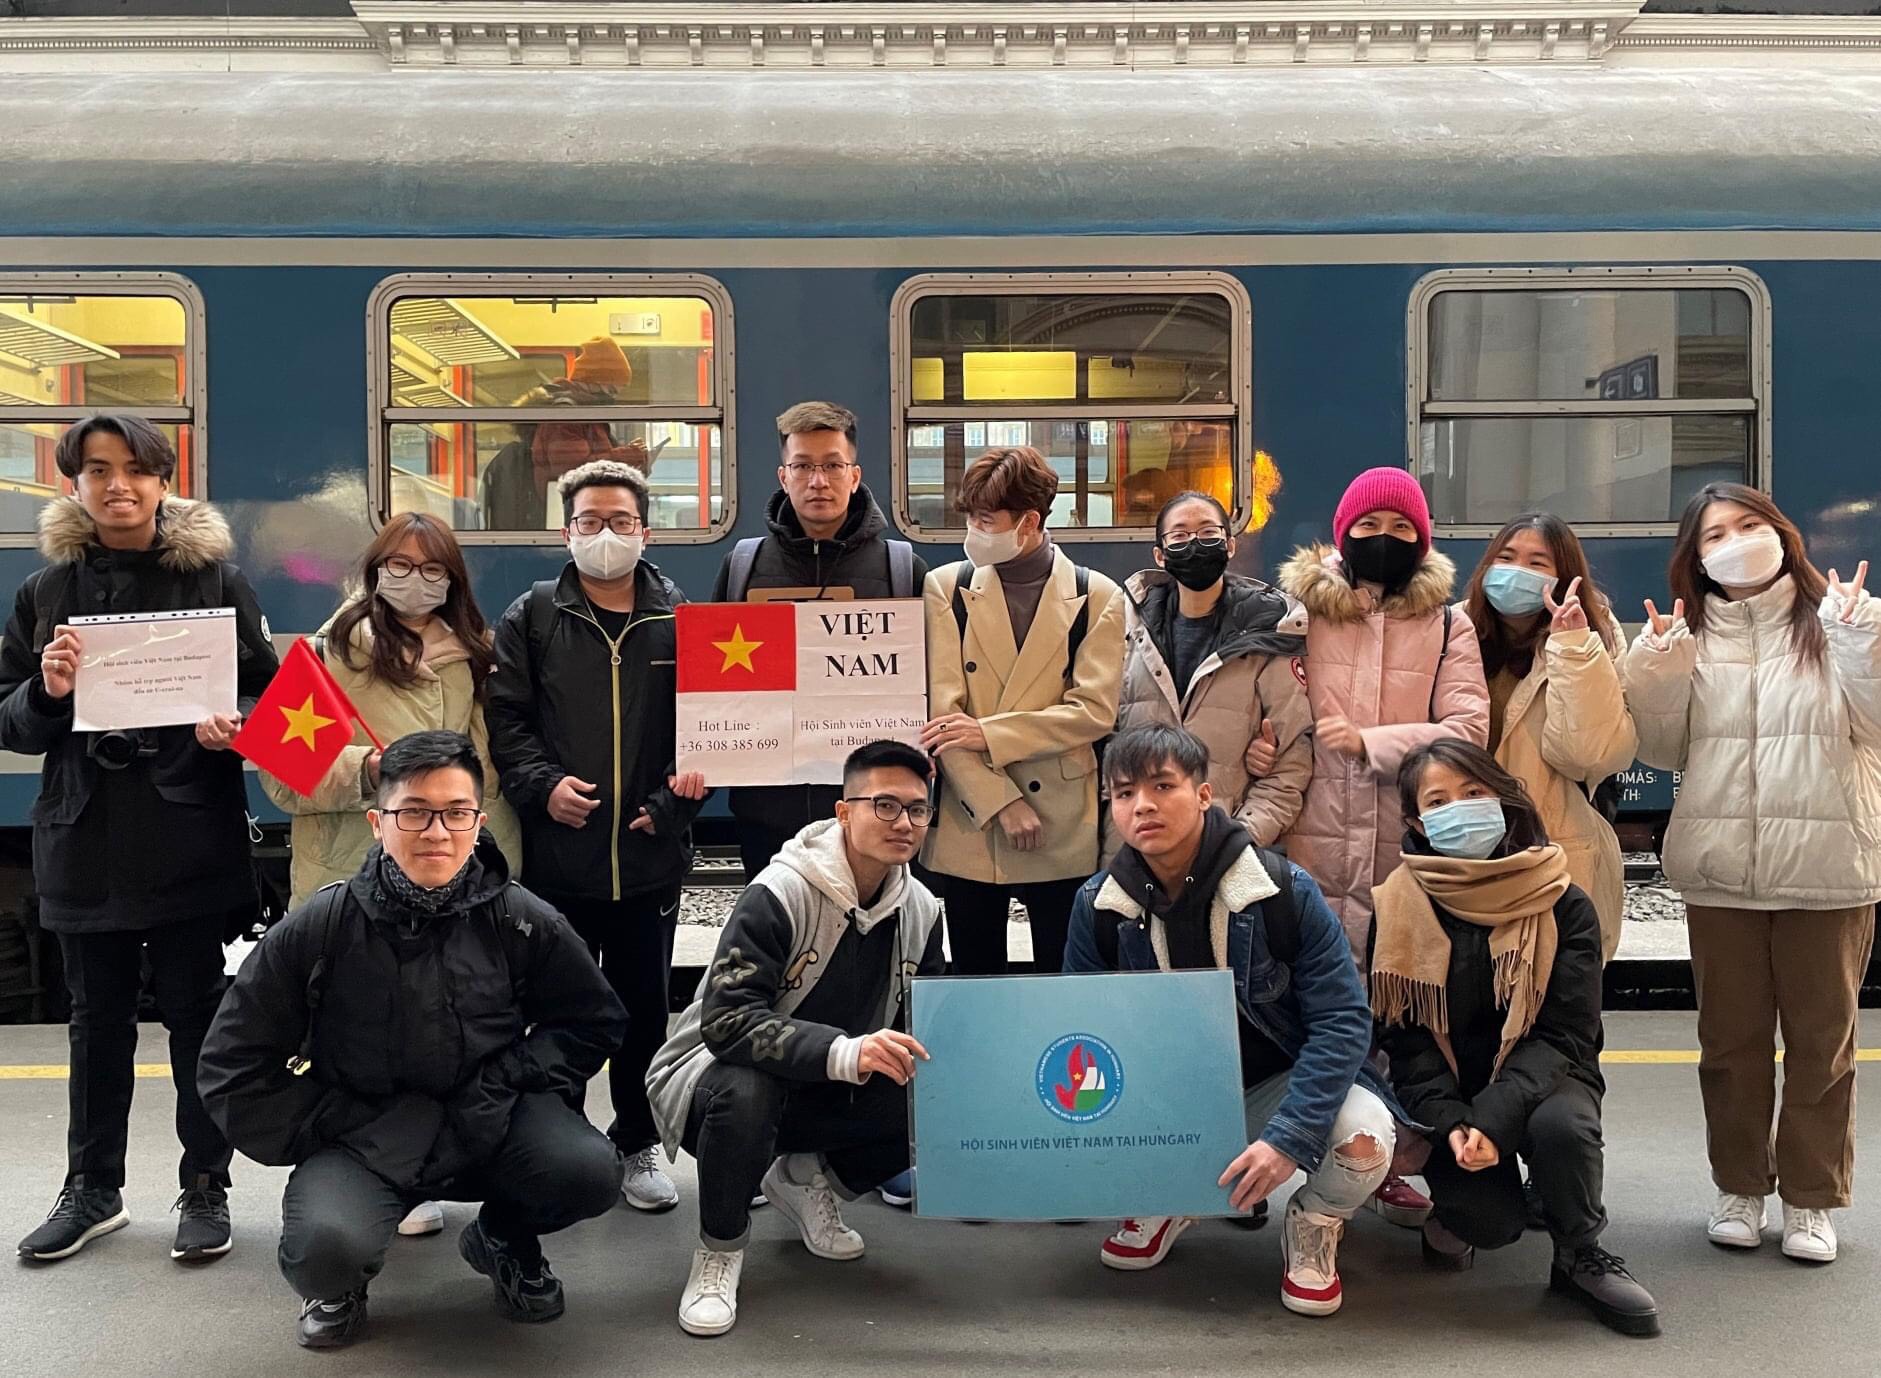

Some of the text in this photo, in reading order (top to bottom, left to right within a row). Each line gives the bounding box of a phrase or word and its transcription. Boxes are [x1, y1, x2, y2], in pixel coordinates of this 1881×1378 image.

[819, 608, 896, 641] VIỆT
[825, 653, 899, 677] NAM
[698, 720, 720, 732] Hot
[724, 720, 751, 731] Line
[800, 717, 925, 732] Hội Sinh viên Việt Nam
[679, 738, 779, 752] +36 308 385 699
[960, 1138, 984, 1153] HỘI
[986, 1139, 1018, 1150] SINH
[1020, 1137, 1050, 1150] VIÊN
[1052, 1136, 1080, 1152] VIỆT
[1083, 1136, 1114, 1148] NAM
[1139, 1133, 1201, 1146] HUNGARY
